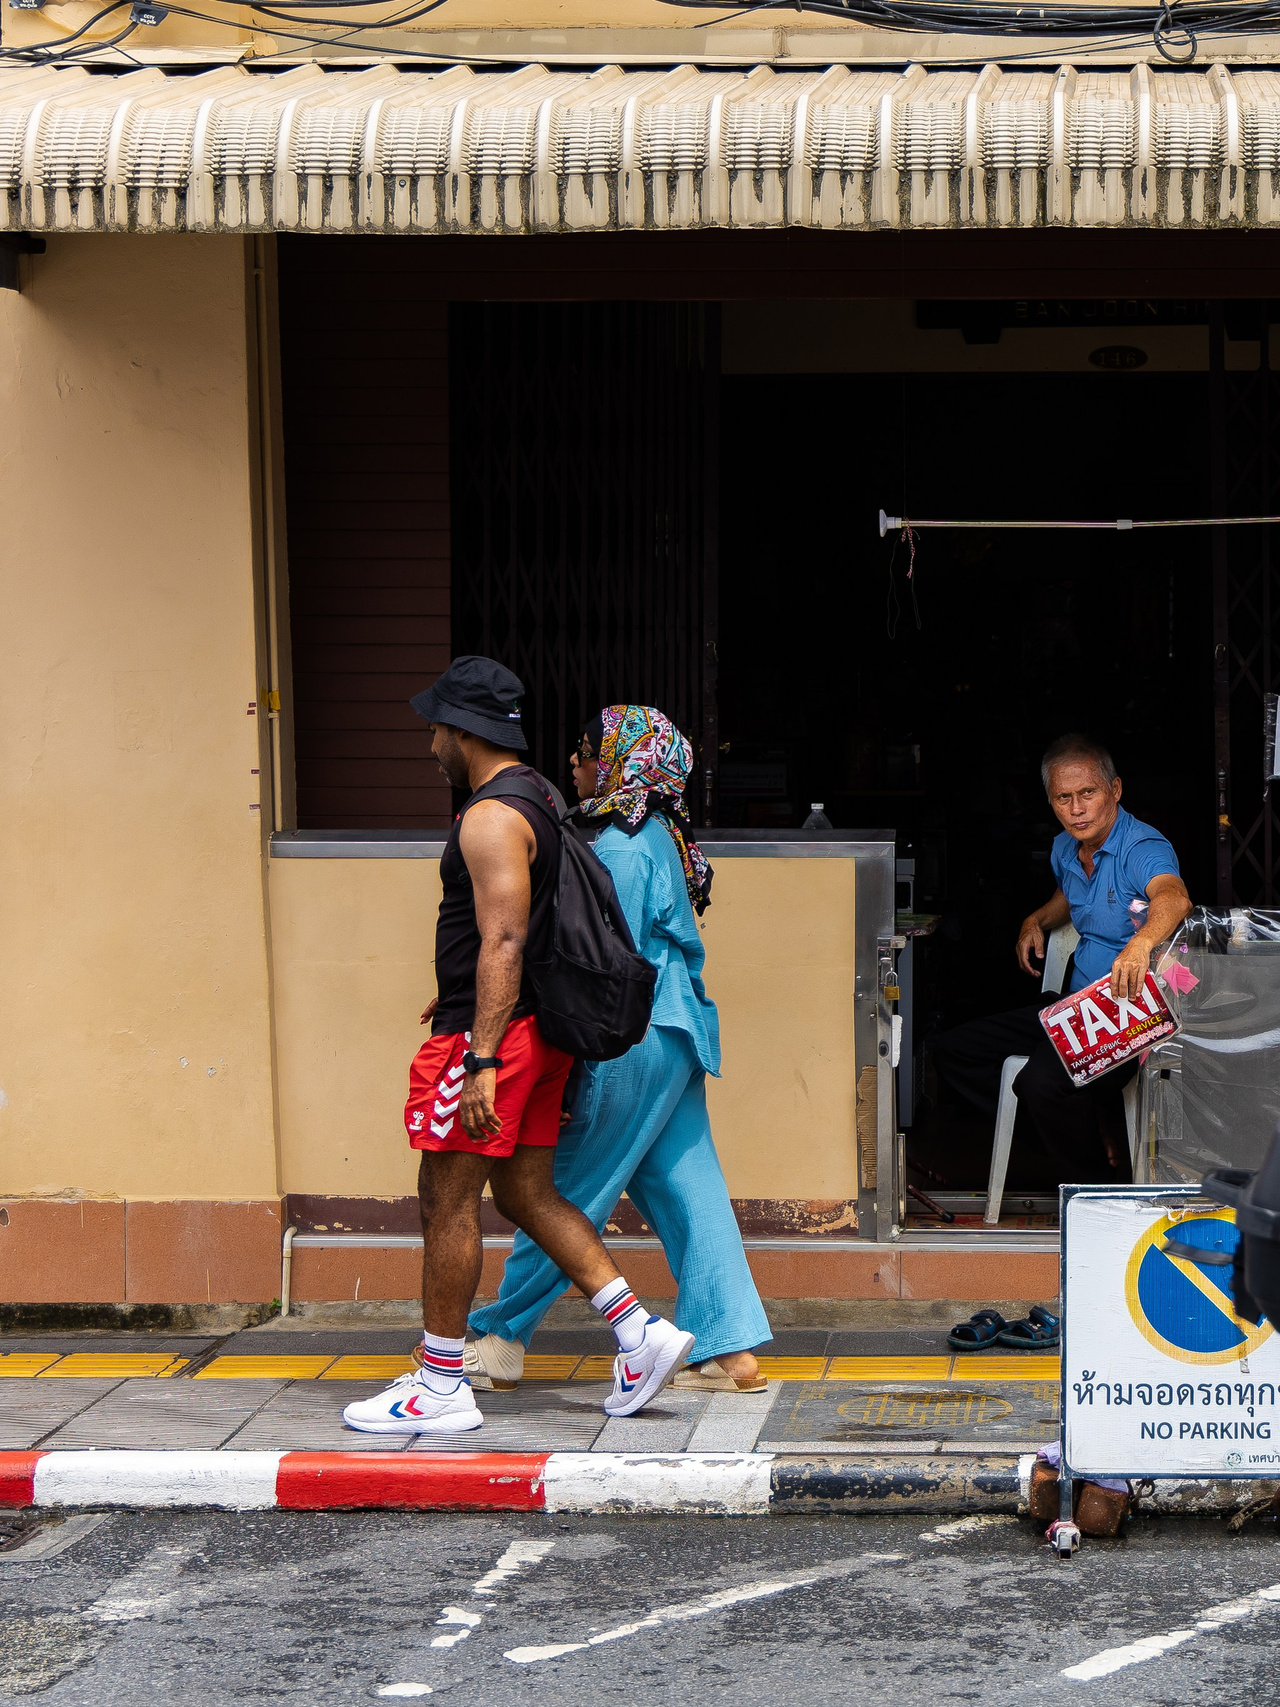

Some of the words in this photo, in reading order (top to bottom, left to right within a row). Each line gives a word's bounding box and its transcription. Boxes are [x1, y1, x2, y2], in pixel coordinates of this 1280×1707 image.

[1099, 351, 1136, 366] 146
[1047, 982, 1161, 1056] TAXI
[1125, 1014, 1163, 1038] SERVICE
[1141, 1421, 1173, 1440] NO
[1179, 1421, 1272, 1440] PARKING
